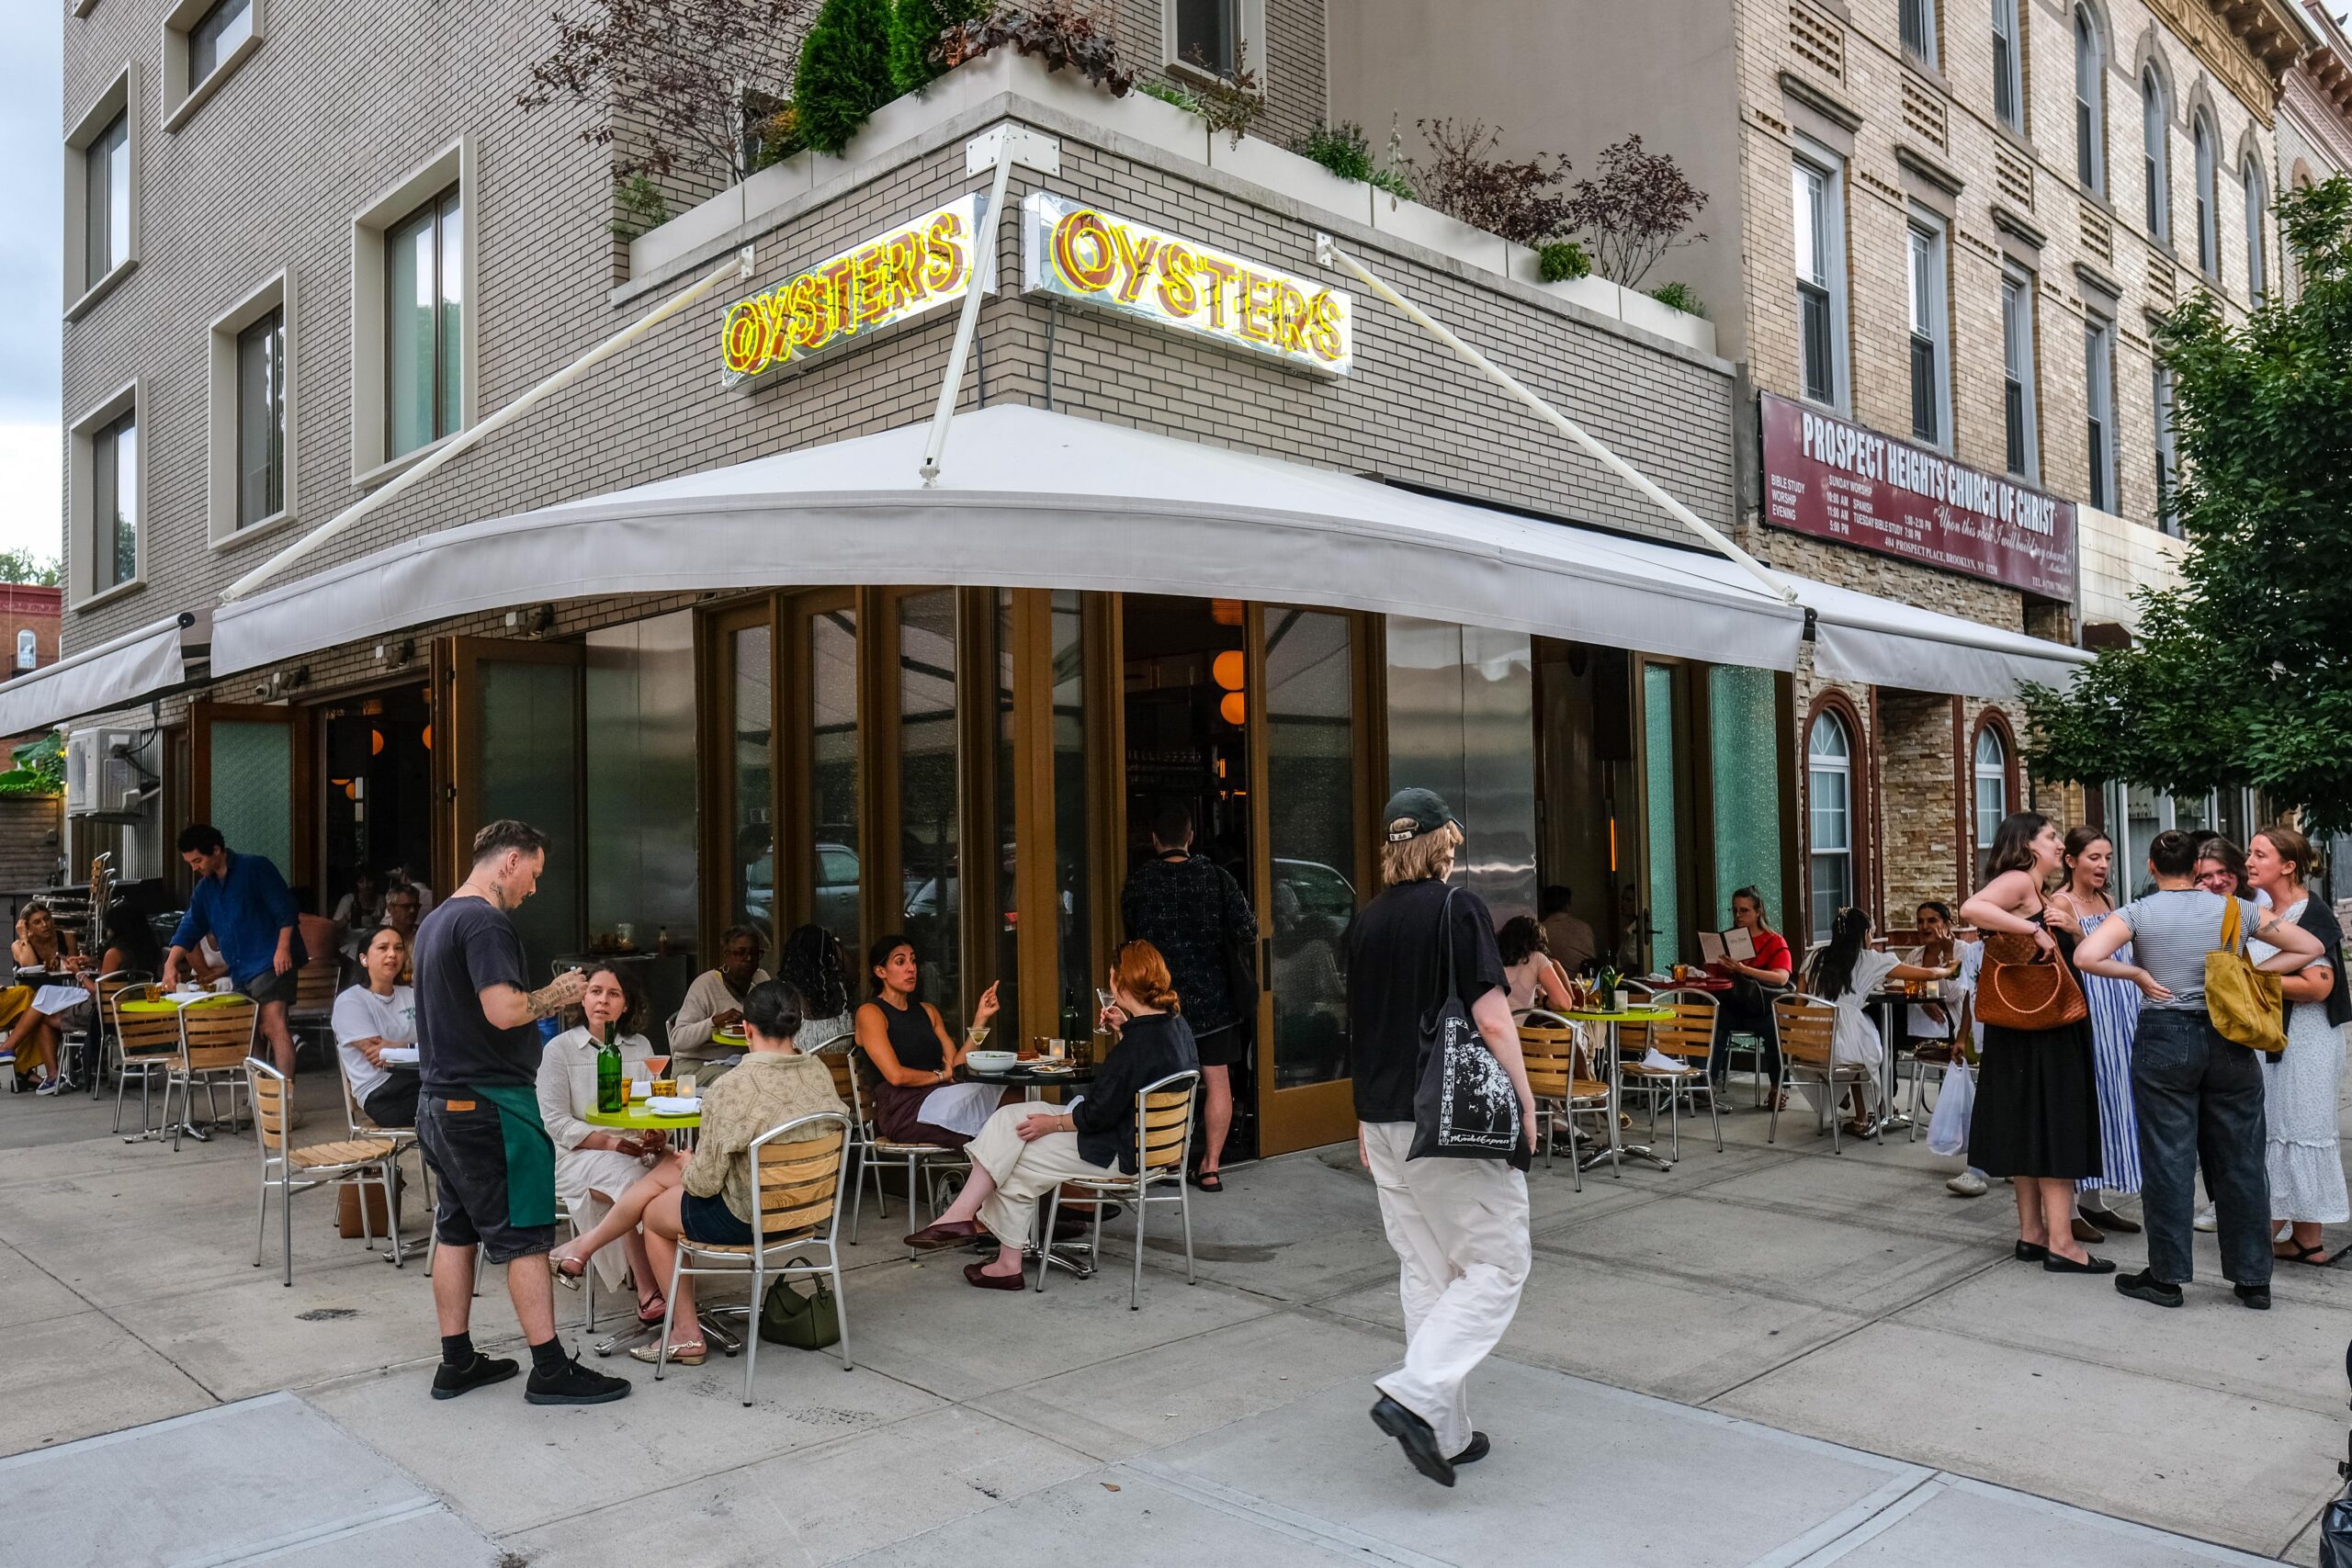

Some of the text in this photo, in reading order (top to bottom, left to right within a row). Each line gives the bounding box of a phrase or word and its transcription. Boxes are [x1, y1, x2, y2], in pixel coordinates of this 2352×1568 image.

[723, 211, 971, 375] OYSTERS
[1049, 209, 1347, 362] OYSTERS
[1770, 473, 1849, 507] BIBLE STUDY 10:00 AM
[1803, 412, 2055, 537] PROSPECT HEIGHTS CHURCH OF CHRIST
[1828, 474, 1872, 497] SUNDAY WORSHIP
[1771, 489, 1849, 521] WORSHIP 11:00 AM
[1771, 503, 1849, 536] EVENING 5:00 PM
[1853, 498, 1873, 514] SPANISH
[1853, 512, 1875, 528] TUESDAY
[1874, 517, 1889, 533] BIBLE
[1888, 522, 1903, 536] STUDY
[1914, 529, 1922, 541] PM
[1962, 516, 1975, 537] this
[1977, 521, 1994, 542] rock
[1994, 525, 2003, 544] I
[2001, 531, 2016, 549] will
[1895, 538, 1926, 557] PROSPECT
[1977, 560, 1985, 571] NY
